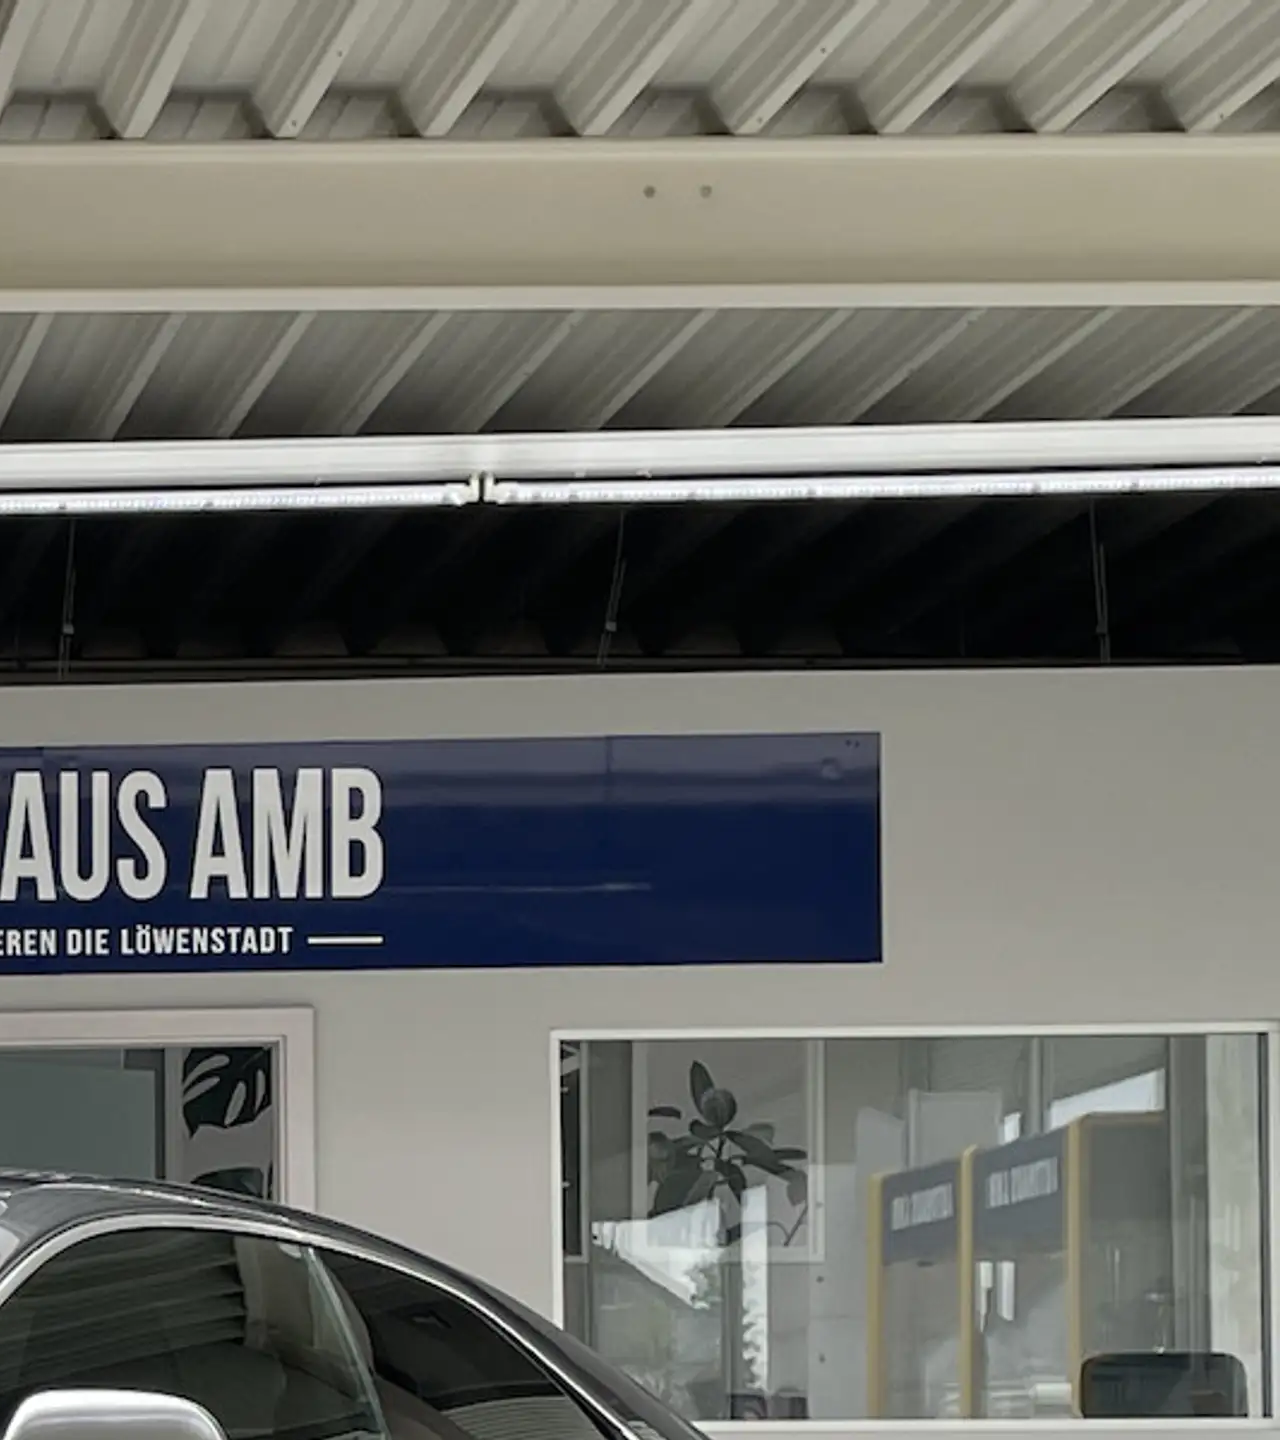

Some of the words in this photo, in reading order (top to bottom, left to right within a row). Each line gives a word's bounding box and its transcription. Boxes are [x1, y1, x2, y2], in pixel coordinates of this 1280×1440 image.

[190, 767, 384, 901] AMB
[66, 928, 110, 956] DIE
[120, 923, 293, 955] LÖWENSTADT
